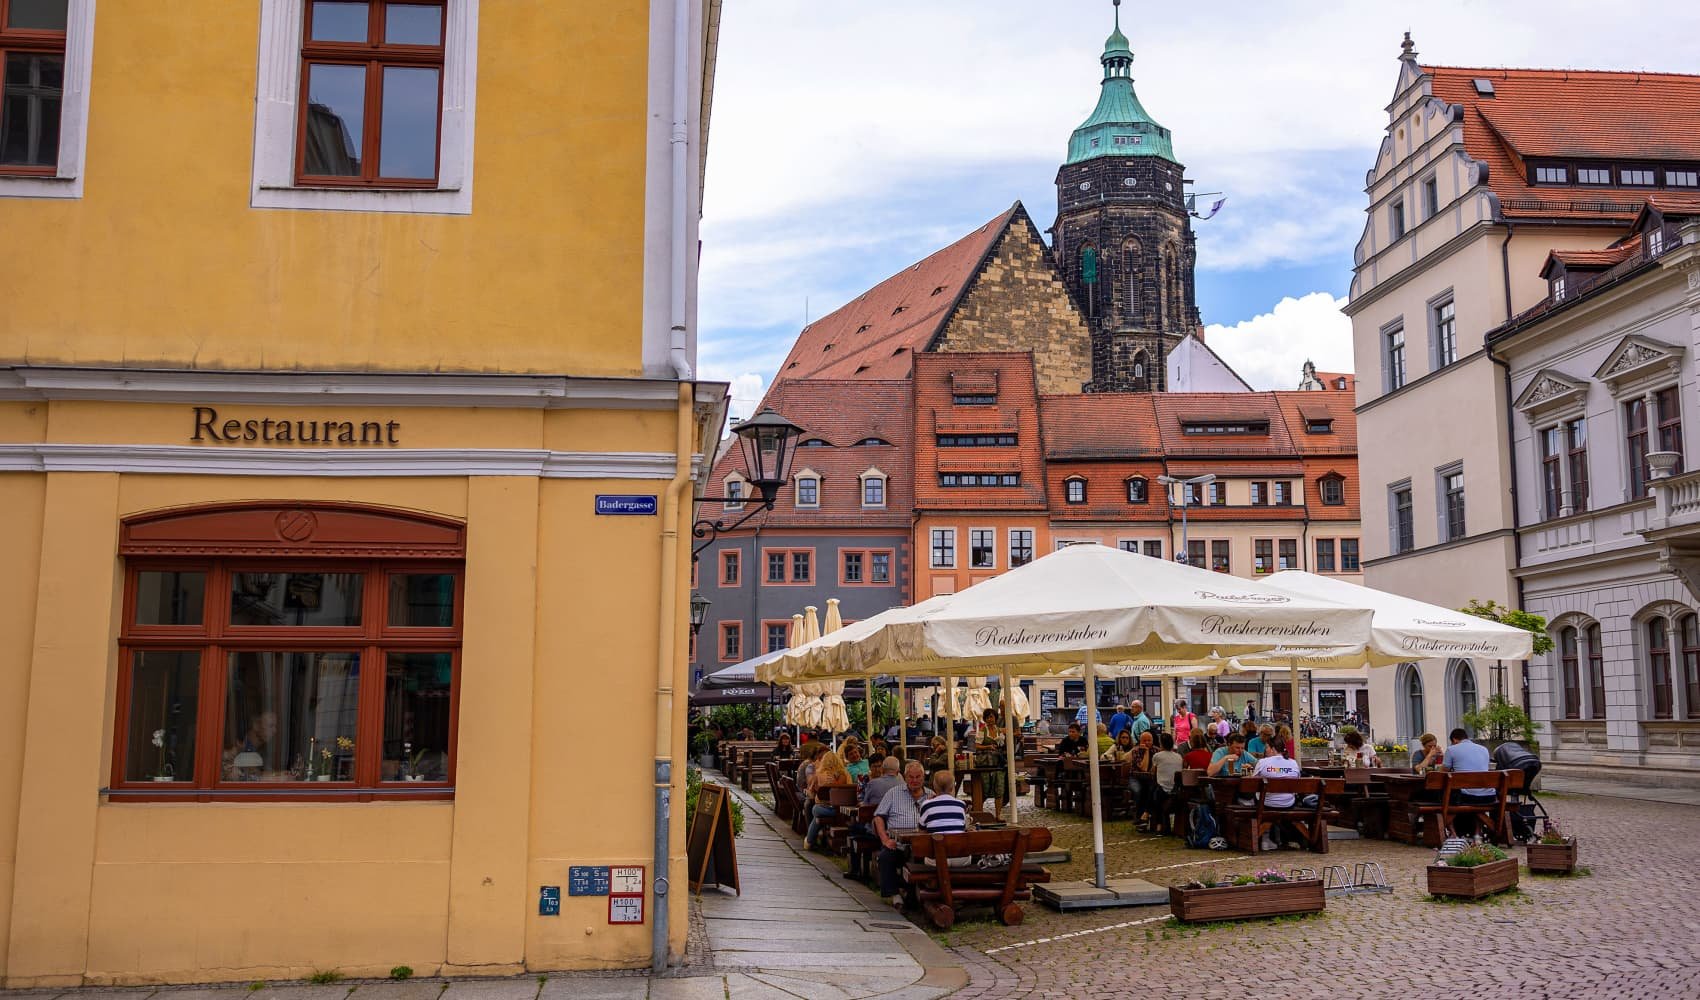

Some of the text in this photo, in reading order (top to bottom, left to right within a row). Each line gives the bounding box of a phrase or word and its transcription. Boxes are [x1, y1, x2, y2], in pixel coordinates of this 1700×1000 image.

[190, 407, 401, 444] Restaurant
[599, 500, 654, 512] Badergasse
[974, 624, 1108, 647] Ratsherrenstuben
[1200, 614, 1331, 636] Ratsherrenstuben
[1401, 635, 1499, 653] Ratsherrenstuben
